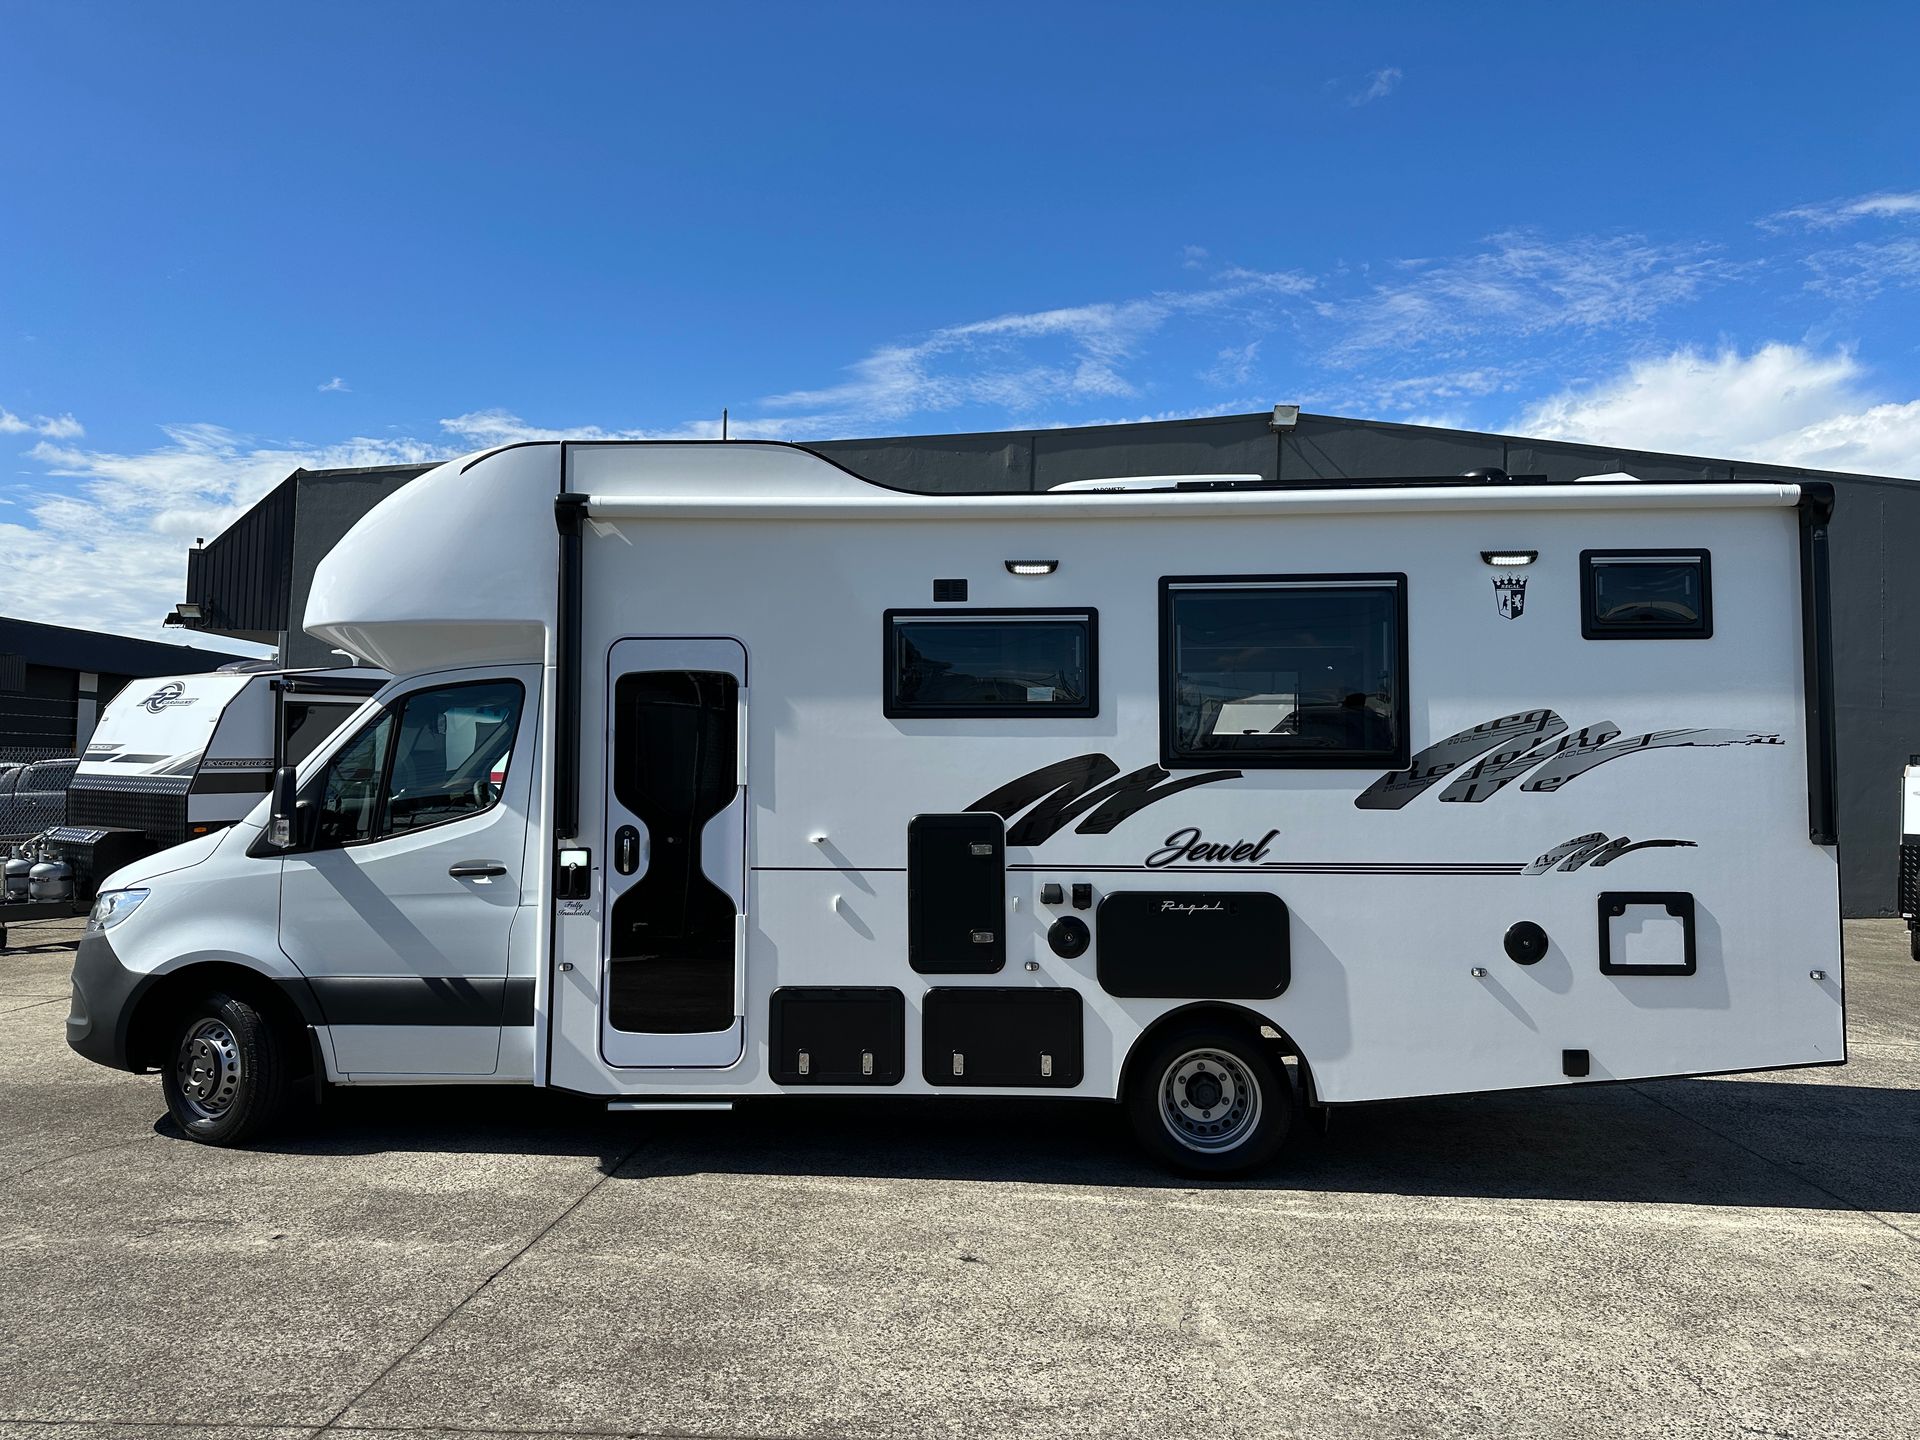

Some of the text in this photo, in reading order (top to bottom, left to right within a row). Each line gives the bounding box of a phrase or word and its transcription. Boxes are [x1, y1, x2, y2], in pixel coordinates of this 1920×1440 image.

[1144, 826, 1281, 869] Jewel
[564, 901, 583, 910] Fully
[1161, 901, 1224, 915] Regal
